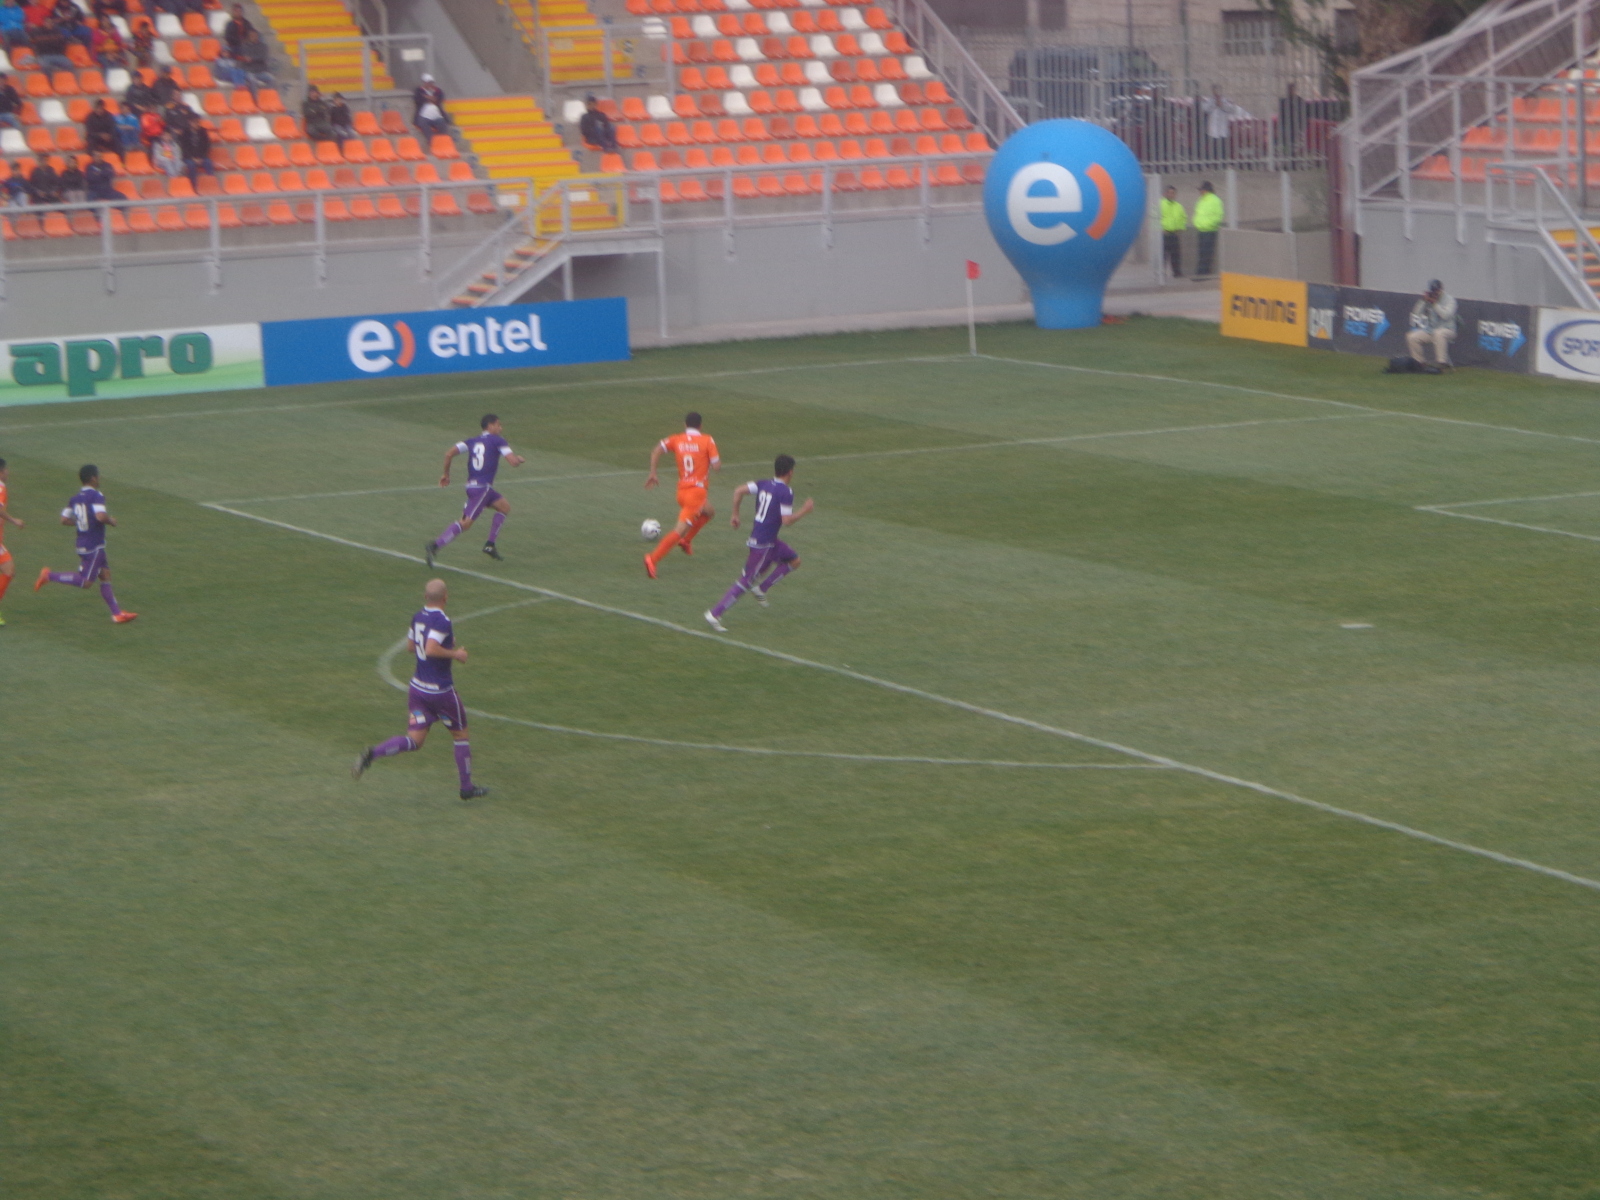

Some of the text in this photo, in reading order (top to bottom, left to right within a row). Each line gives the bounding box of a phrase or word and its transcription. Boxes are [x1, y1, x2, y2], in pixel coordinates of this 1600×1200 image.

[1230, 294, 1297, 325] FINNING
[1308, 307, 1336, 340] CAT
[1342, 304, 1386, 324] POWER
[428, 313, 548, 358] entel
[1476, 319, 1521, 339] POWER
[8, 331, 213, 397] apro
[472, 442, 485, 471] 3
[683, 454, 694, 477] 9
[414, 622, 427, 660] 5
